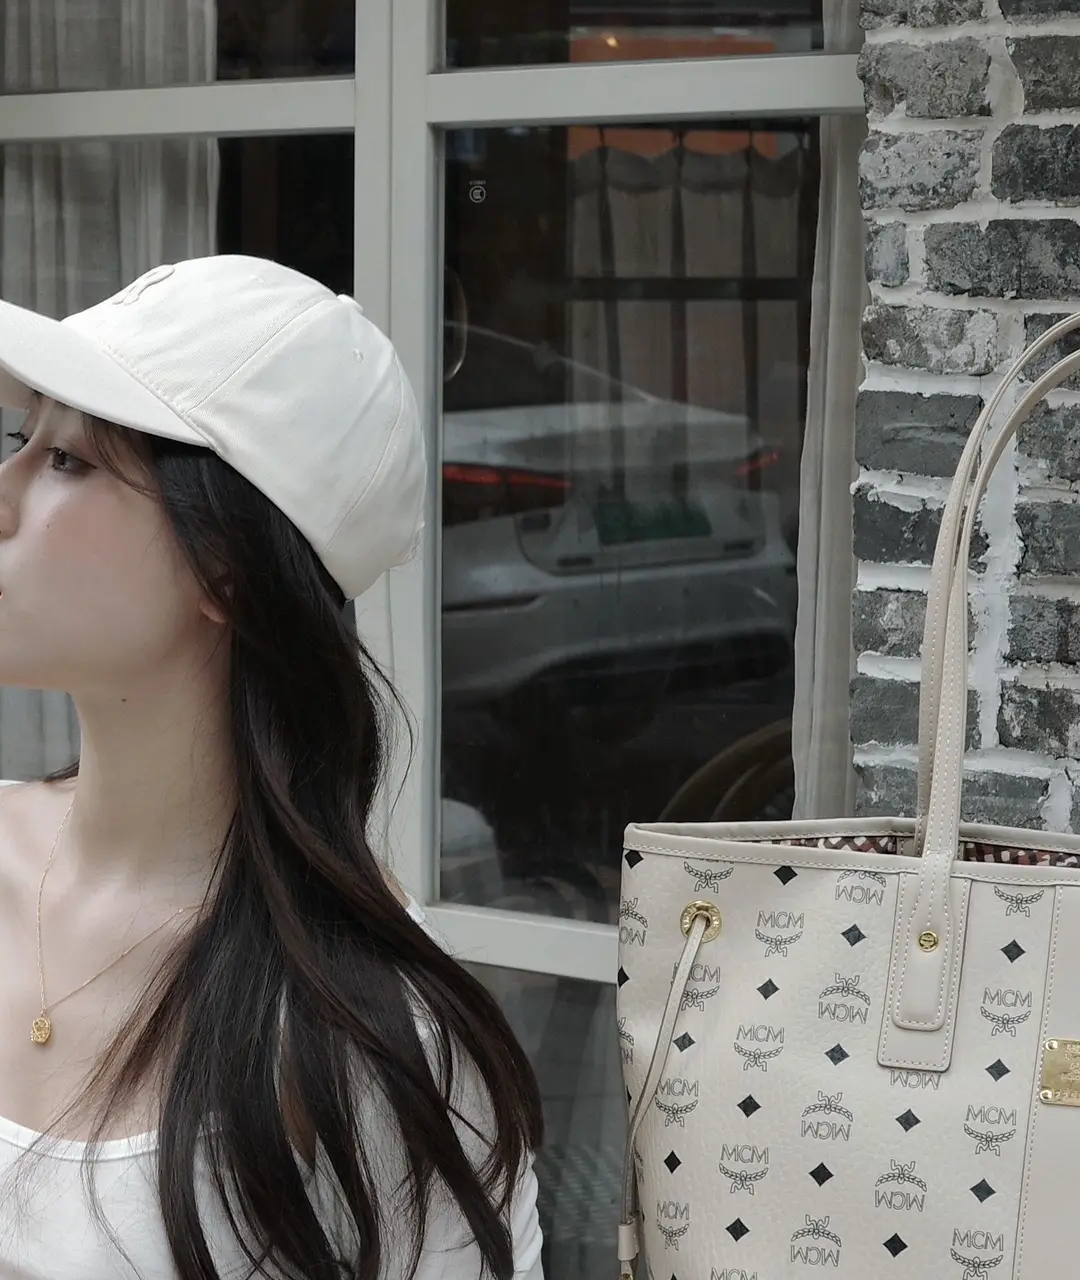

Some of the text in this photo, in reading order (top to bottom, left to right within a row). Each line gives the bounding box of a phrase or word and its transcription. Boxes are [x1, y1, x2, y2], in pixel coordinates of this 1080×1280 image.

[835, 885, 885, 906] MCM
[757, 910, 805, 929] MCM
[982, 987, 1033, 1008] MCM
[818, 1001, 869, 1024] MCM
[736, 1024, 785, 1043] MCM
[655, 1078, 699, 1097] MCM
[890, 1071, 941, 1091] MCM
[966, 1104, 1017, 1126] MCM
[801, 1121, 852, 1142] MCM
[720, 1143, 769, 1164] MCM
[657, 1201, 690, 1220] MCM
[875, 1189, 925, 1212] MCM
[952, 1228, 1004, 1252] MCM
[790, 1245, 840, 1267] MCM
